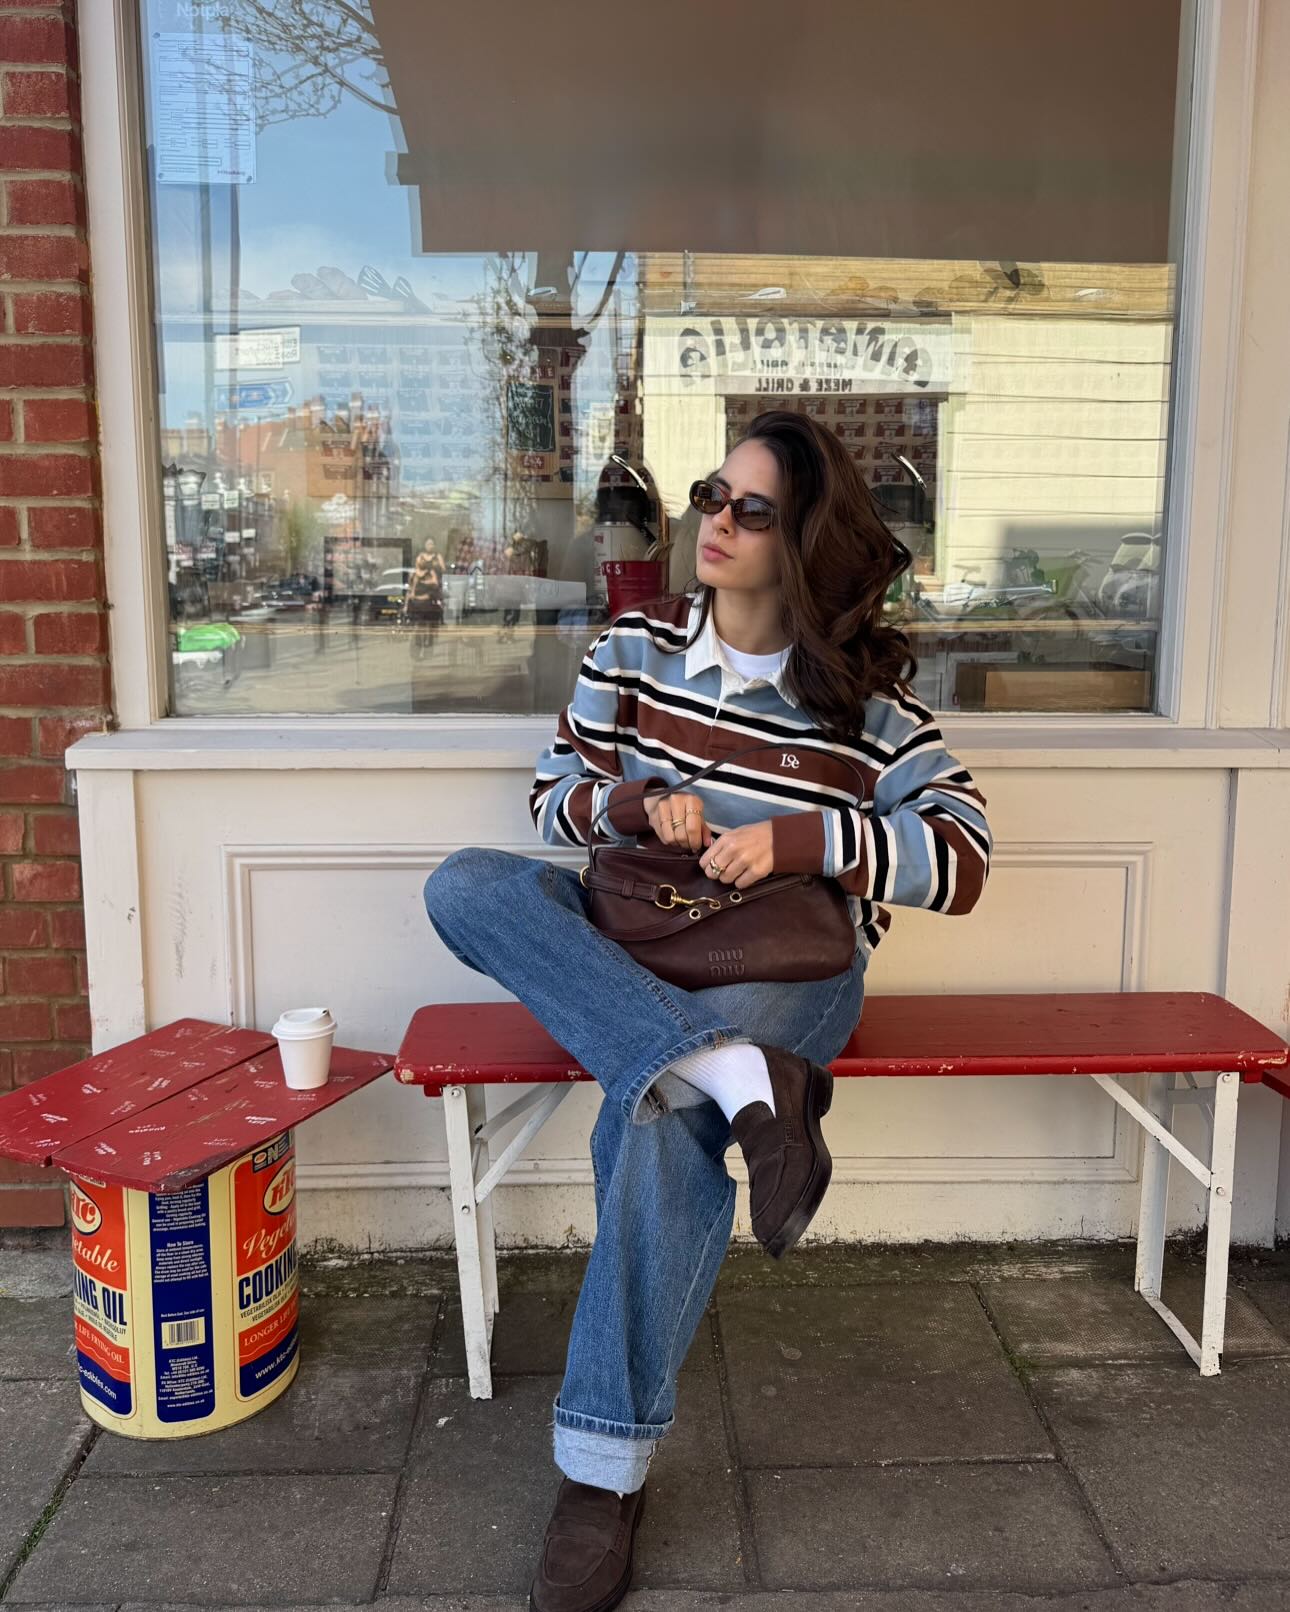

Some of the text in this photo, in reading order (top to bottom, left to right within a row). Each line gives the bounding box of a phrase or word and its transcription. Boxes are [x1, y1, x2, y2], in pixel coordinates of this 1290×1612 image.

[102, 1290, 128, 1326] OIL
[243, 1319, 280, 1347] LONGER
[111, 1351, 125, 1363] OIL
